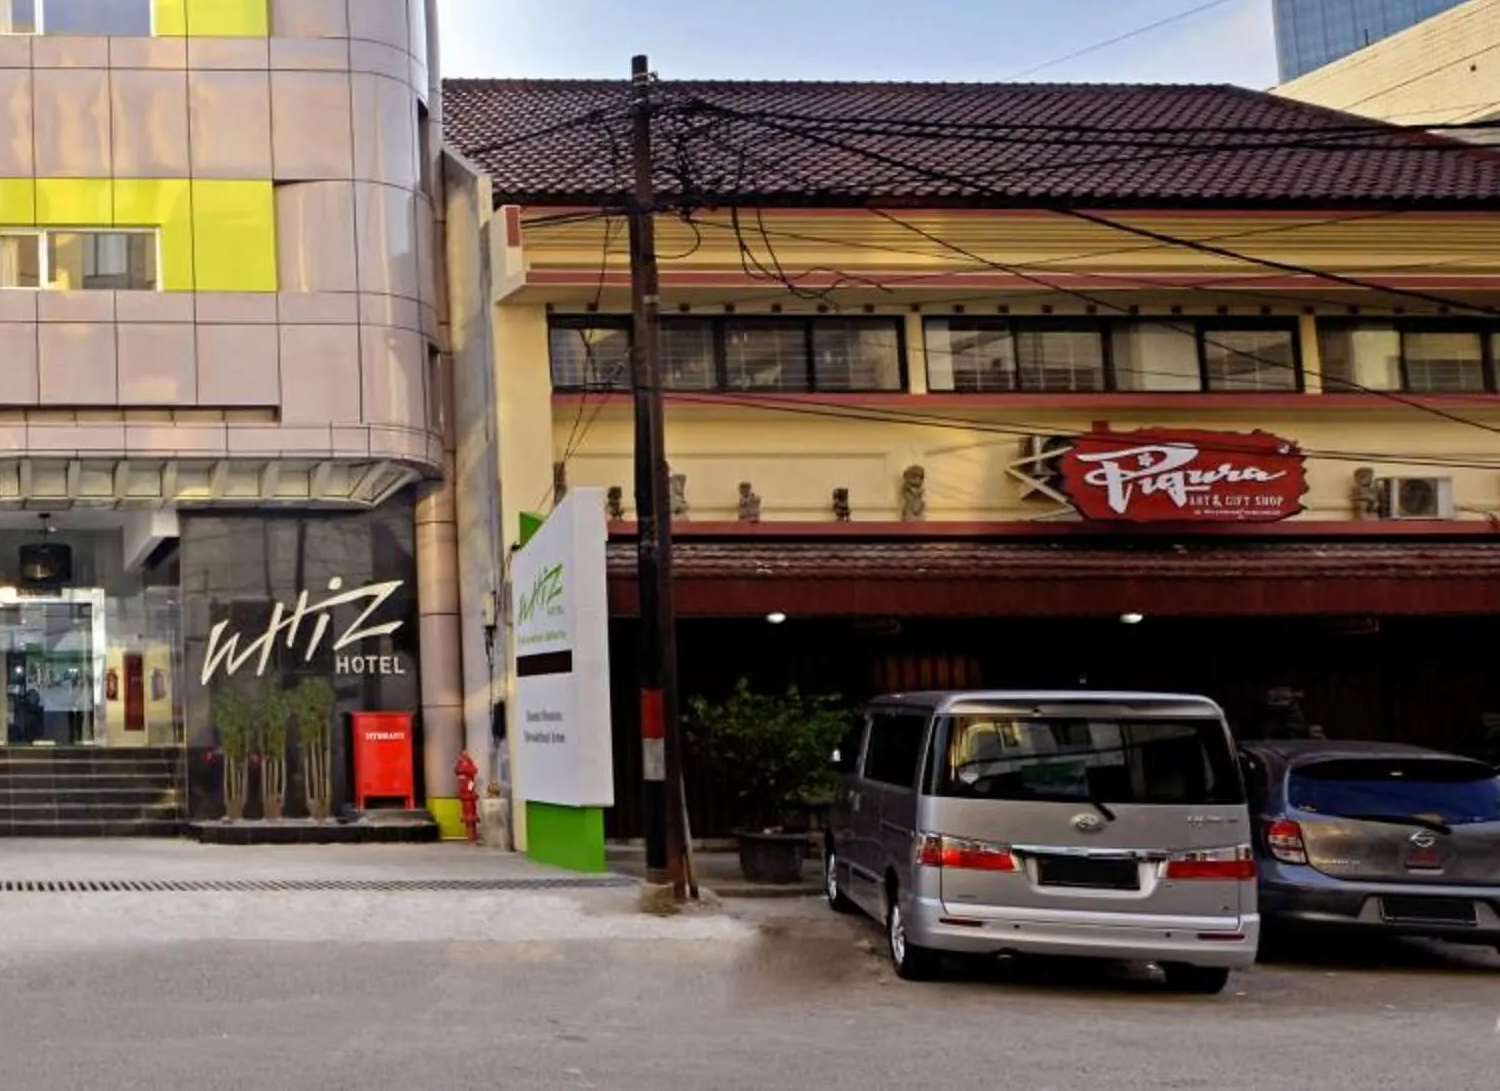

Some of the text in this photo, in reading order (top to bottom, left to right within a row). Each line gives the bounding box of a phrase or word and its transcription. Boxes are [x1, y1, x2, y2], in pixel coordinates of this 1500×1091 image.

[1225, 496, 1250, 506] GIFT
[1255, 496, 1284, 506] SHOP
[335, 655, 405, 674] HOTEL
